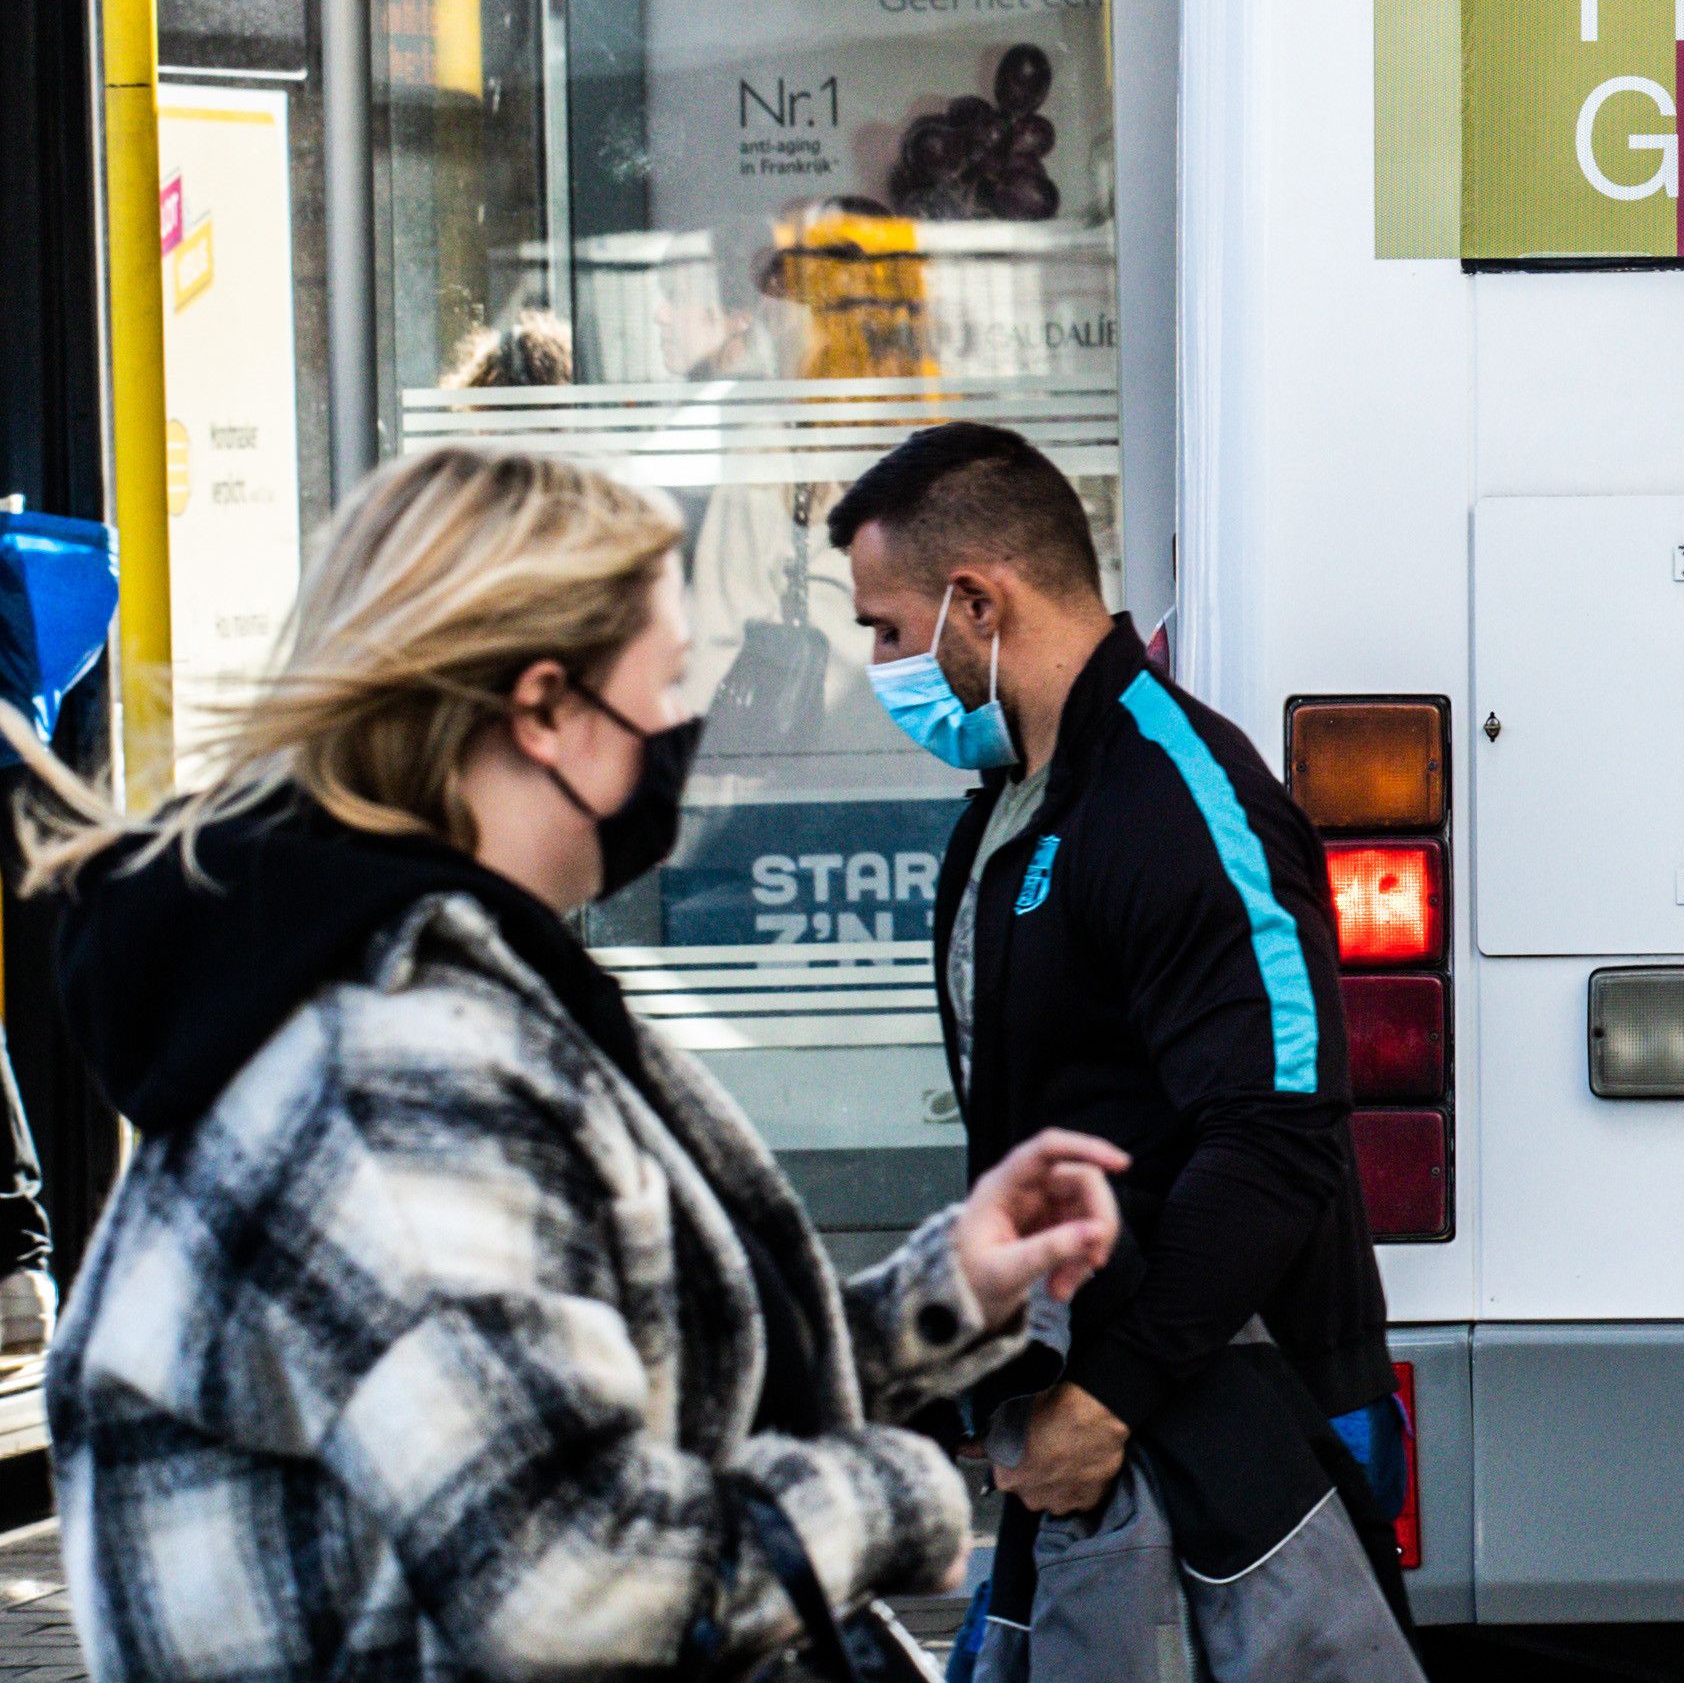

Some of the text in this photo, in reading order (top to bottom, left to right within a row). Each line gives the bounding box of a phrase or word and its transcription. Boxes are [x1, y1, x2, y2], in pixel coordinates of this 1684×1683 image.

[740, 76, 838, 127] Nr.1
[740, 139, 821, 156] anti-aging
[752, 851, 947, 905] STAR
